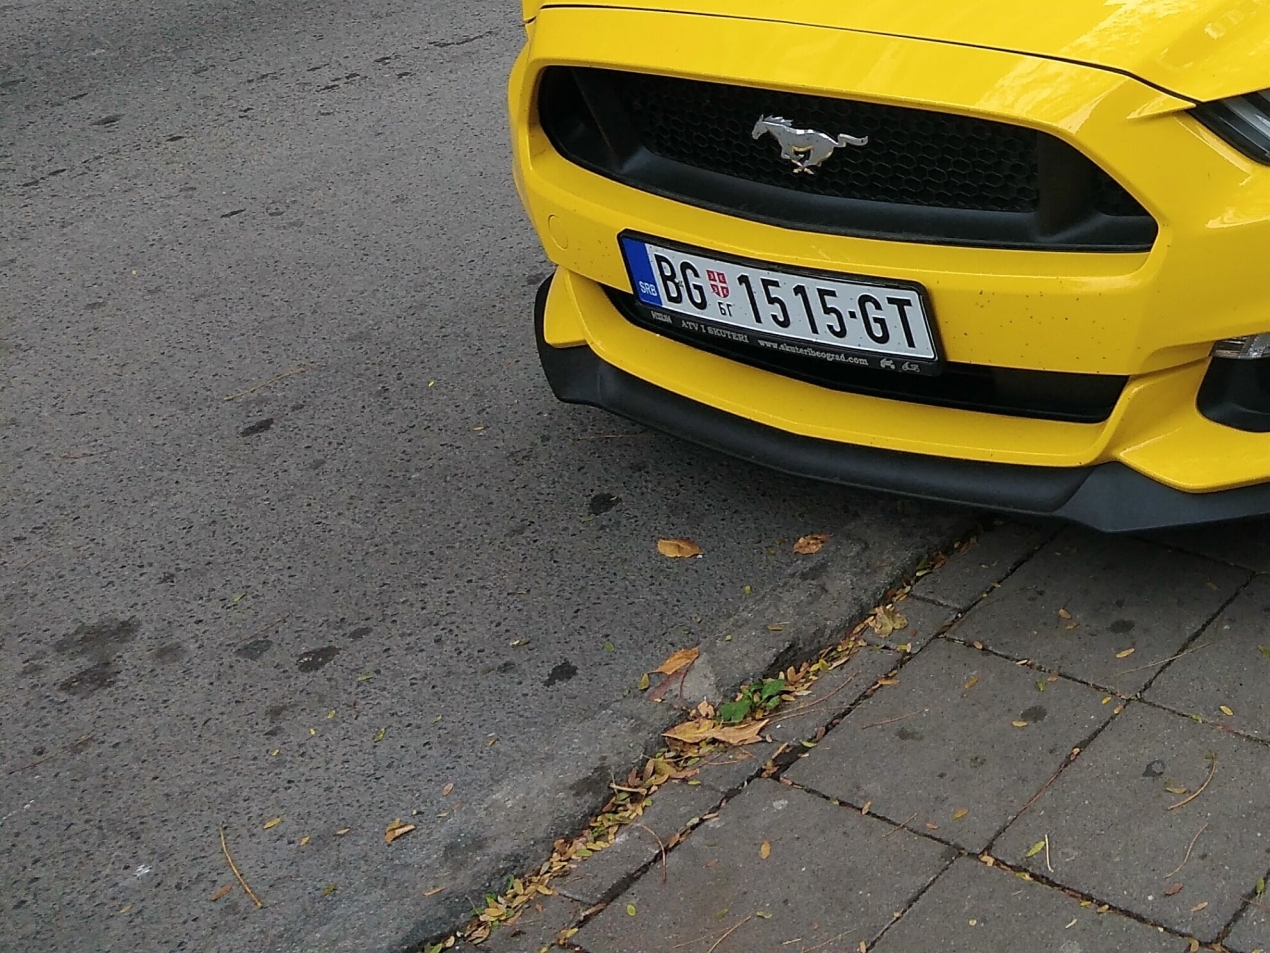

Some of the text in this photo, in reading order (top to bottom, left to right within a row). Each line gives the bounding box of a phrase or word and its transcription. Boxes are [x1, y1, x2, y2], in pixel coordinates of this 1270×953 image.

[638, 280, 658, 297] SRB
[653, 252, 708, 311] BG
[681, 320, 699, 331] ATV
[707, 327, 750, 343] SKUTERI
[757, 339, 870, 366] www.skuteribeograd.com
